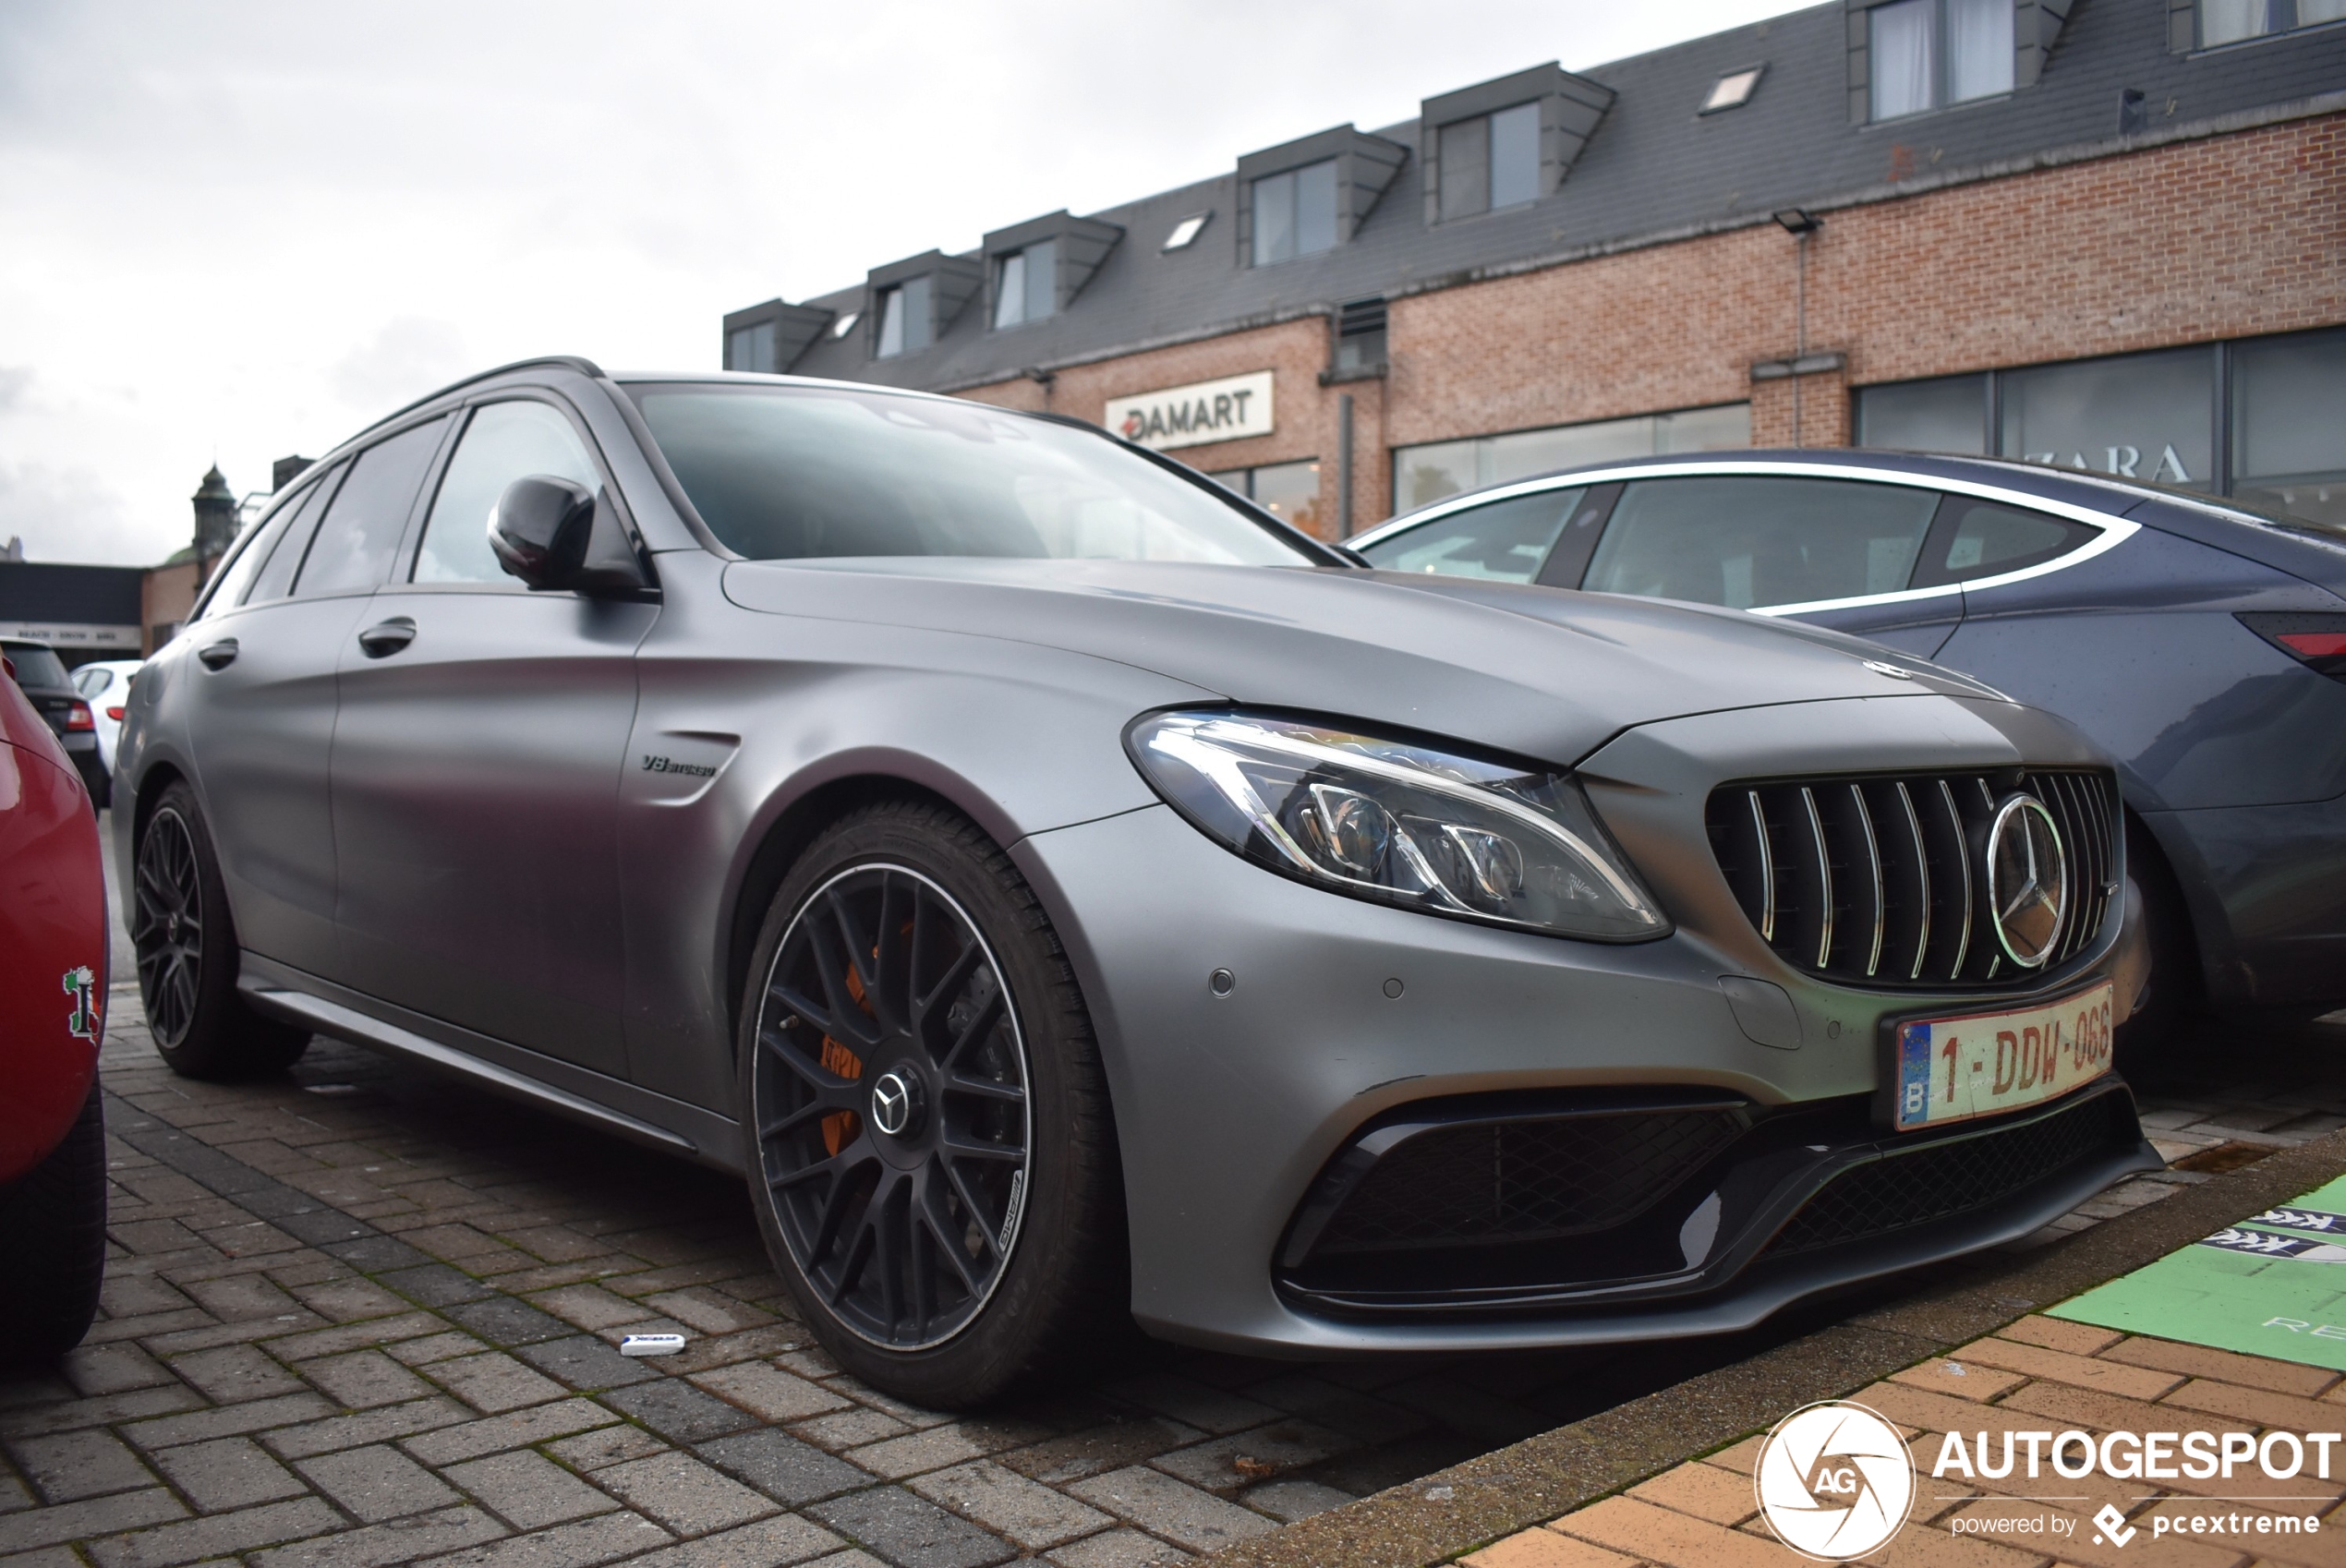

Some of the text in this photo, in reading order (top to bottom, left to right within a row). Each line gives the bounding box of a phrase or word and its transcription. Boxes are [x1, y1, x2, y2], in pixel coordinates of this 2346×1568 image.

[1123, 389, 1252, 440] DAMART
[642, 754, 670, 772] V8
[1905, 1082, 1925, 1115] B
